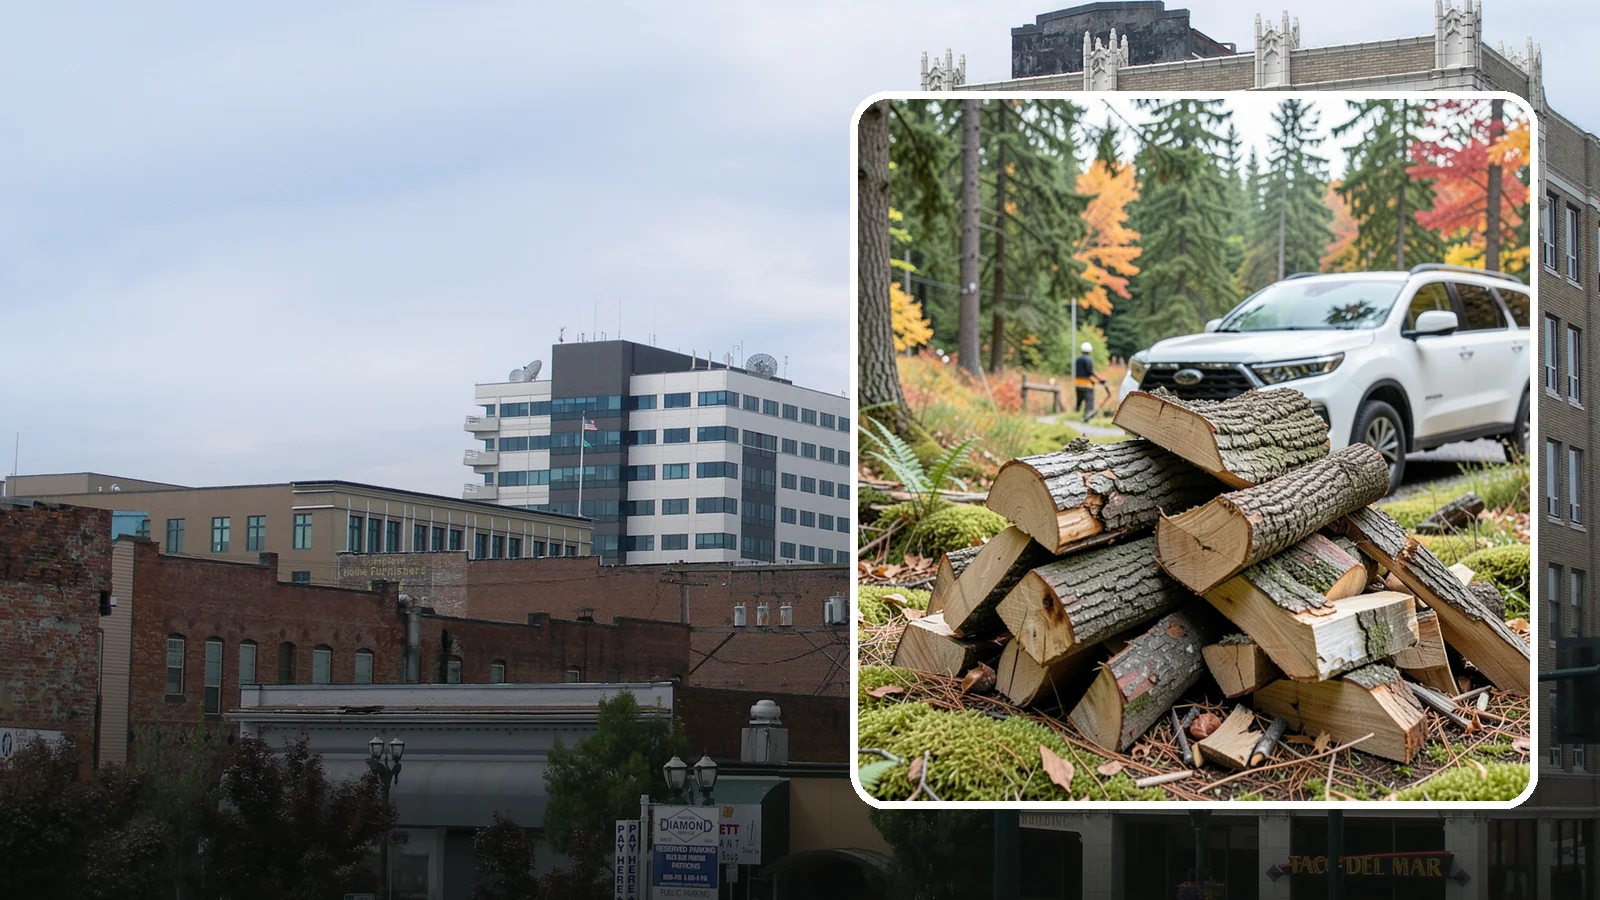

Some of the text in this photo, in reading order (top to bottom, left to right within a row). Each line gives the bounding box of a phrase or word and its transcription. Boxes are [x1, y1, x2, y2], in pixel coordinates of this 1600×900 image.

[371, 566, 426, 576] Furnishers
[660, 818, 713, 832] DIAMOND
[1022, 815, 1070, 827] BUILDING
[719, 824, 740, 835] ETT
[655, 845, 716, 854] RESERVED PARKING
[616, 825, 625, 894] PAY HERE
[627, 824, 637, 893] PAY HERE
[671, 861, 701, 870] PATRONS
[1290, 855, 1443, 878] TAC DEL MAR
[660, 888, 710, 898] PUBLIC PARKING
